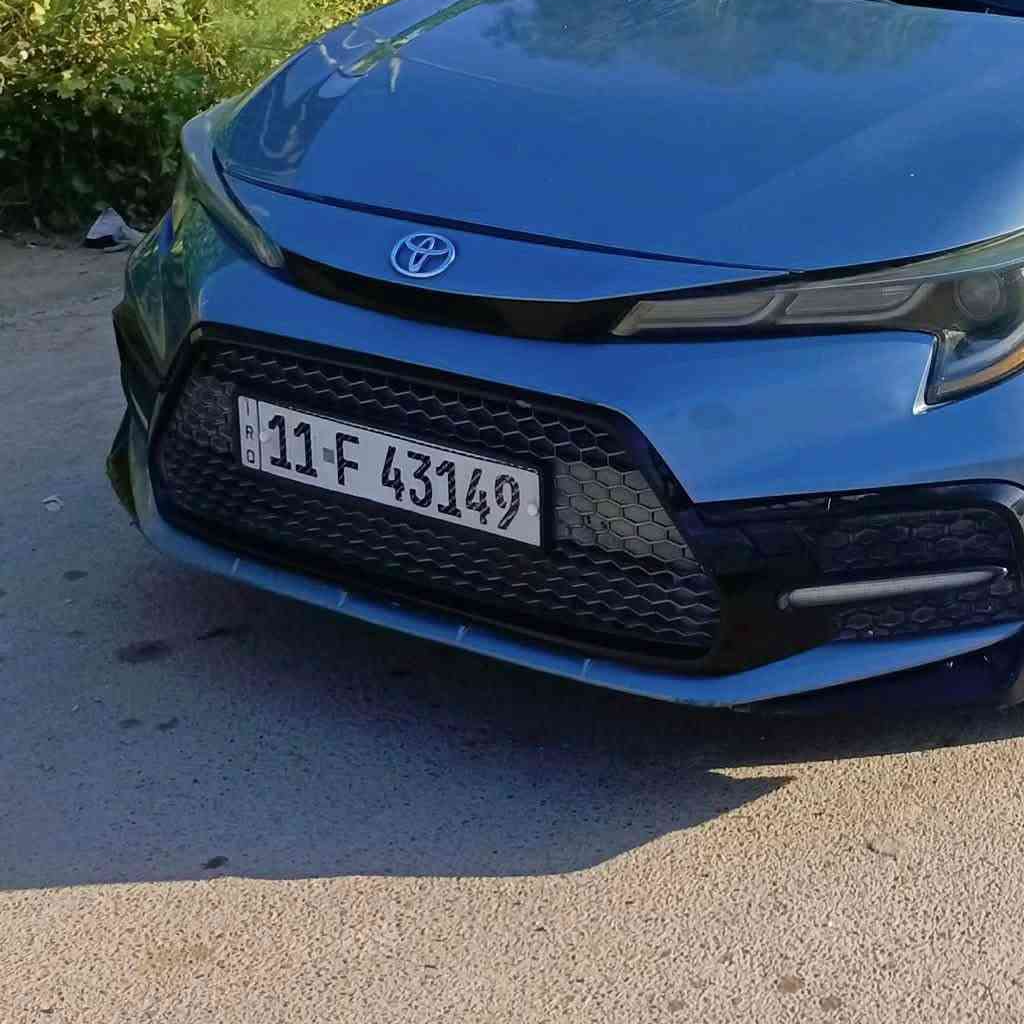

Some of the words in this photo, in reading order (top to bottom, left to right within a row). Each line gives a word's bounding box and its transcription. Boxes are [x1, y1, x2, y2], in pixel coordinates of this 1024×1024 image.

[268, 414, 318, 478] 11
[335, 431, 361, 486] F
[381, 445, 521, 531] 43149
